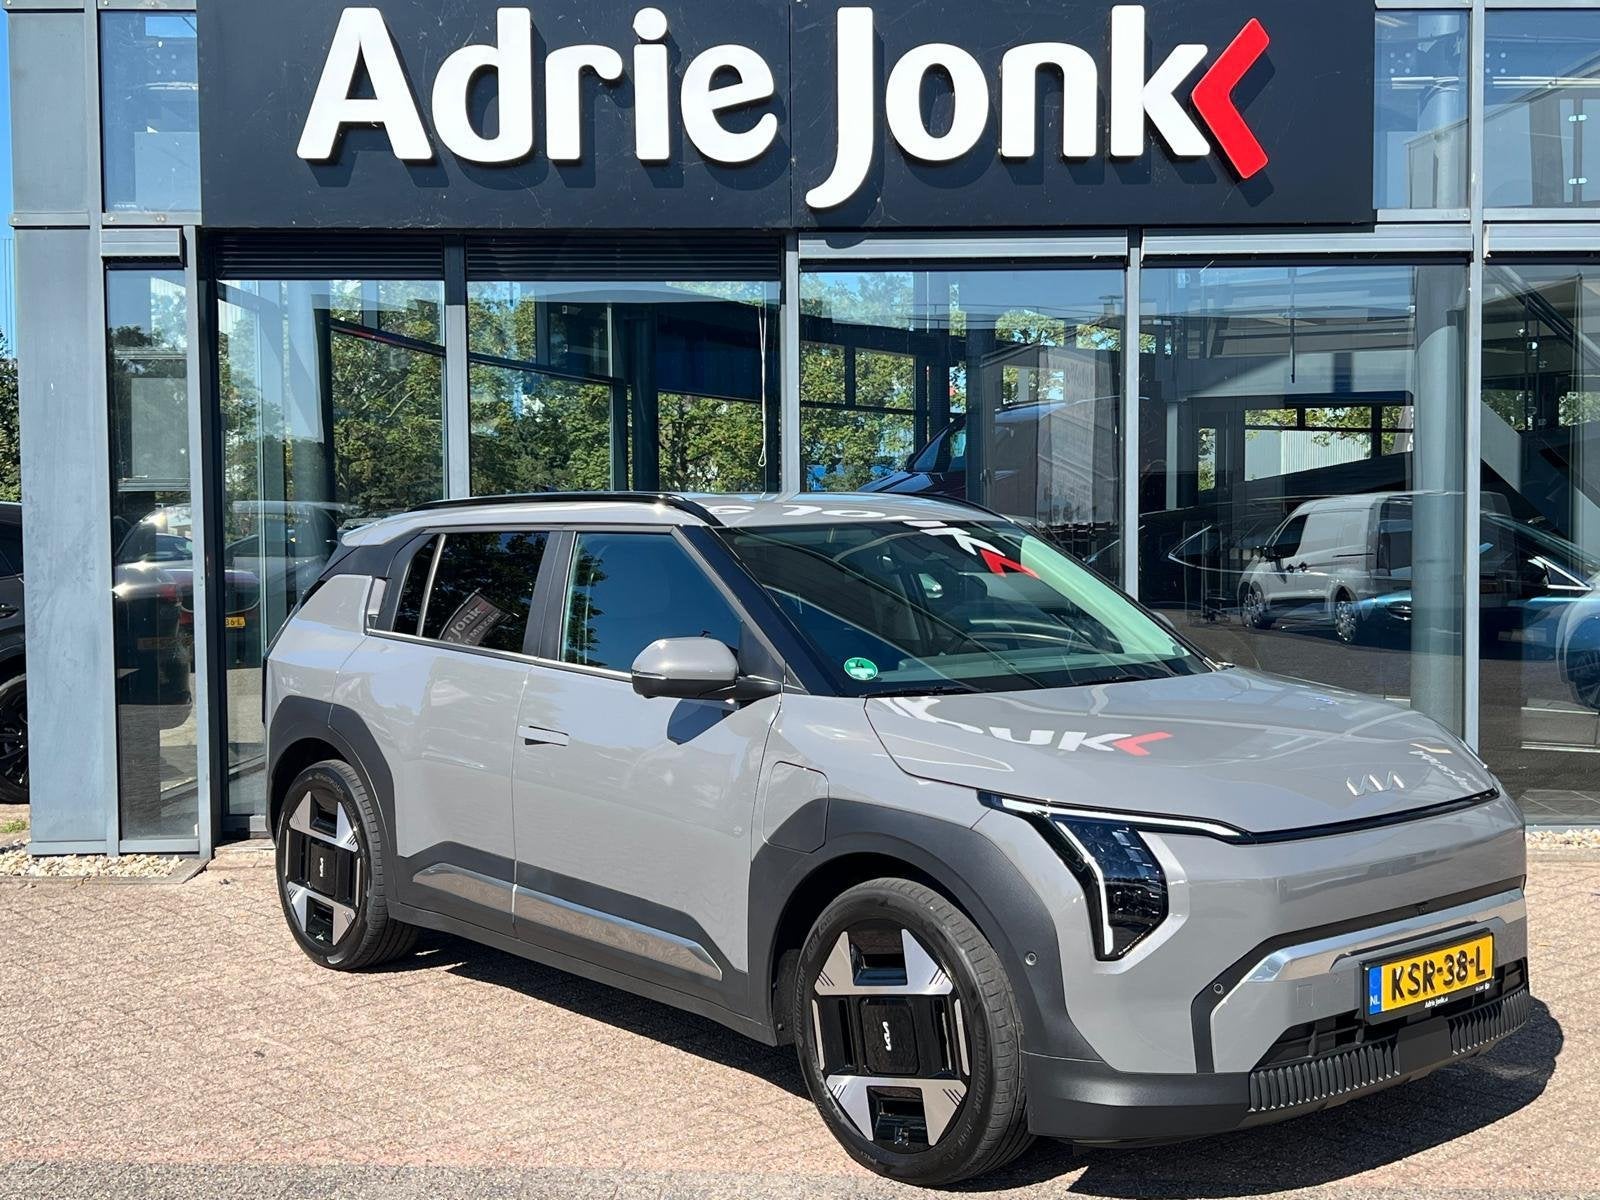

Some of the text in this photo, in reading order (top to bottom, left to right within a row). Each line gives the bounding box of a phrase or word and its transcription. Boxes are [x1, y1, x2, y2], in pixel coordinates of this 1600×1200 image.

[296, 5, 1210, 209] Adrie Jonk
[1370, 994, 1380, 1006] NL
[1391, 945, 1486, 1001] KSR-38-L
